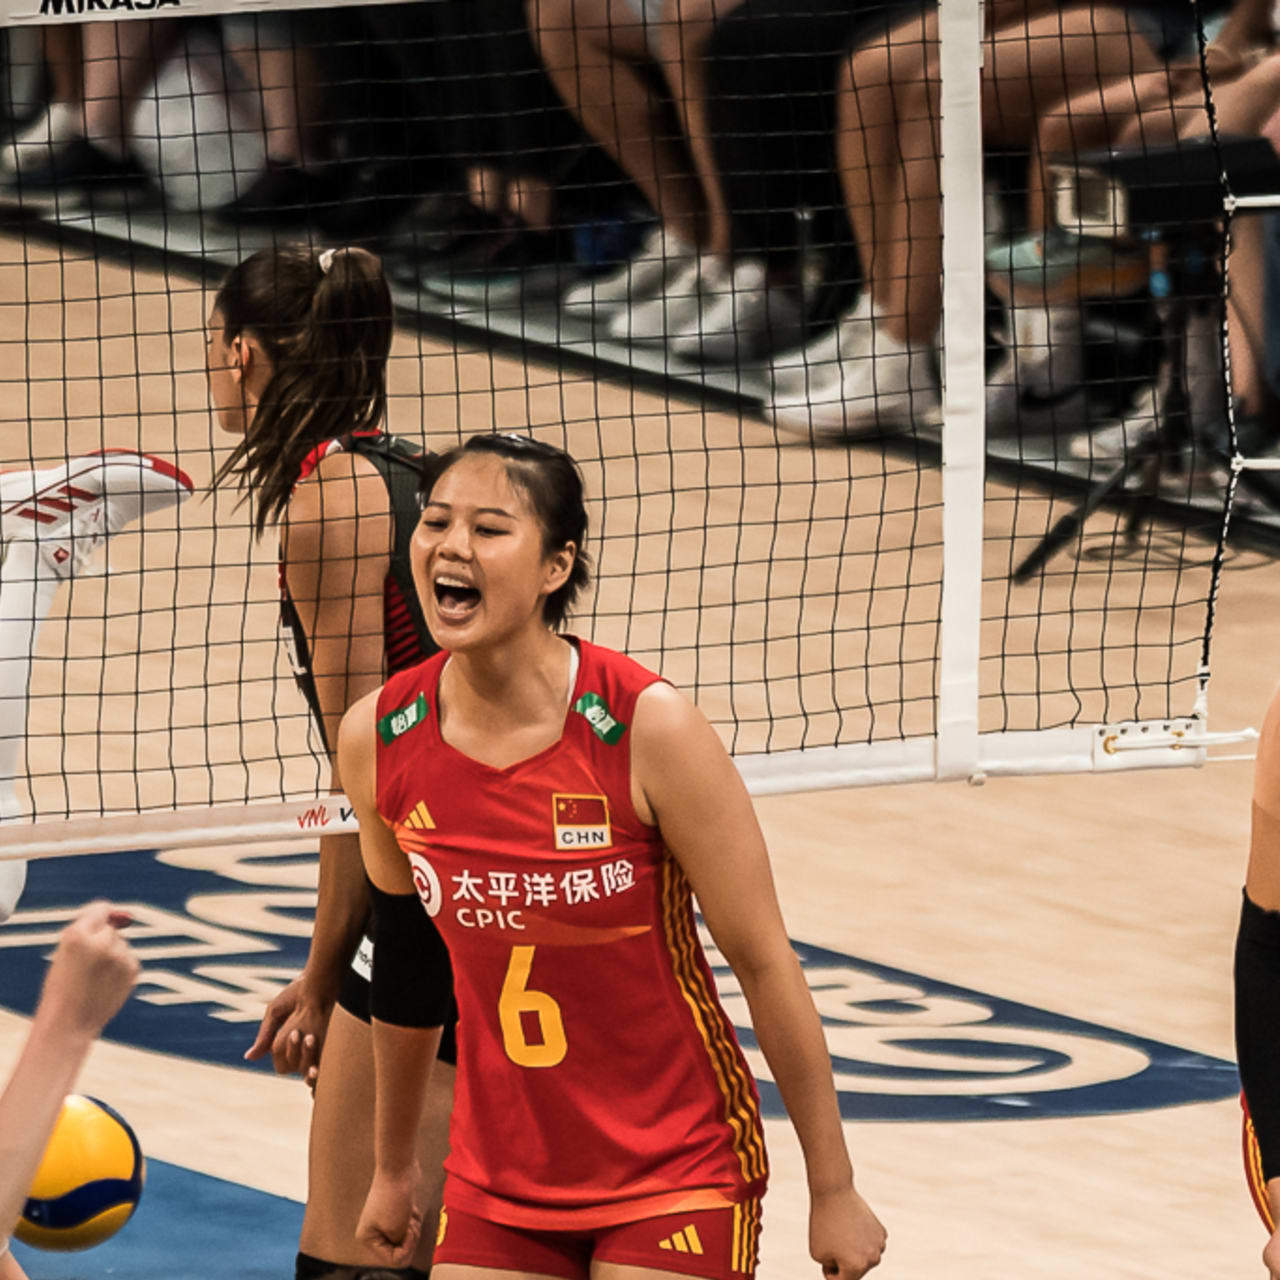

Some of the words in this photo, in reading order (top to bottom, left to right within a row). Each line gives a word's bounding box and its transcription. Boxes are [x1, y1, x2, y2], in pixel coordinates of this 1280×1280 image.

[561, 831, 605, 845] CHN
[451, 859, 636, 907] 太平洋保险
[456, 908, 526, 930] CPIC
[498, 945, 568, 1068] 6
